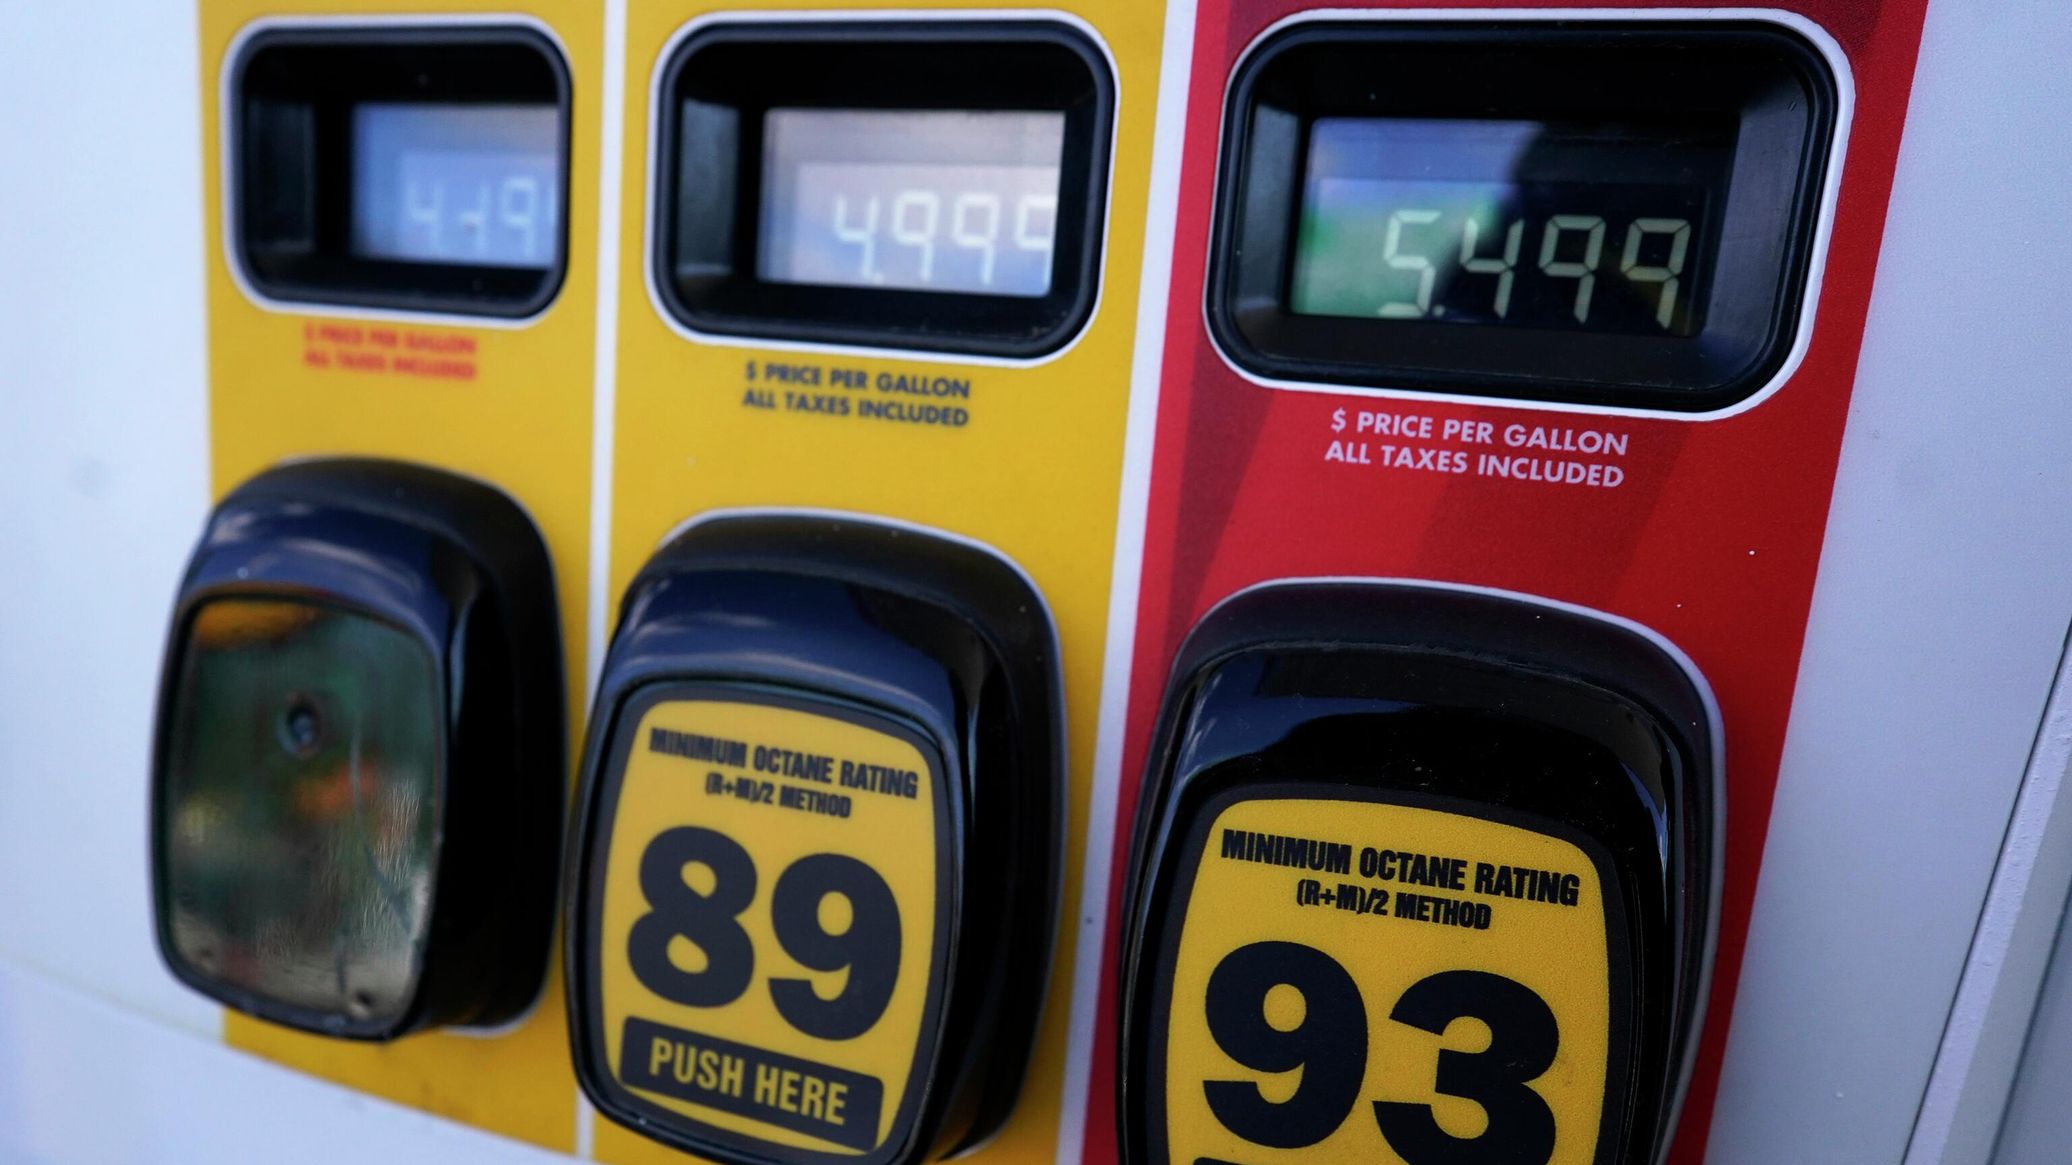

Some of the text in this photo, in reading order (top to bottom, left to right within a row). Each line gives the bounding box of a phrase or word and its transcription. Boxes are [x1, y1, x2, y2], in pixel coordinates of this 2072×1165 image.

[1378, 209, 1691, 329] 5.499
[742, 388, 969, 427] ALL TAXES INCLUDED
[746, 361, 970, 399] $ PRICE PER GALLON
[1331, 408, 1628, 456] $ PRICE PER GALLON
[1324, 440, 1624, 489] ALL TAXES INCLUDED
[649, 727, 919, 800] MINIMUM OCTANE RATING
[778, 784, 852, 819] METHOD
[1220, 828, 1581, 907] MINIMUM OCTANE RATING
[627, 826, 903, 1042] 89
[1296, 878, 1493, 931] (R+M)/2 METHOD
[648, 1036, 849, 1127] PUSH HERE
[1203, 940, 1560, 1165] 93
